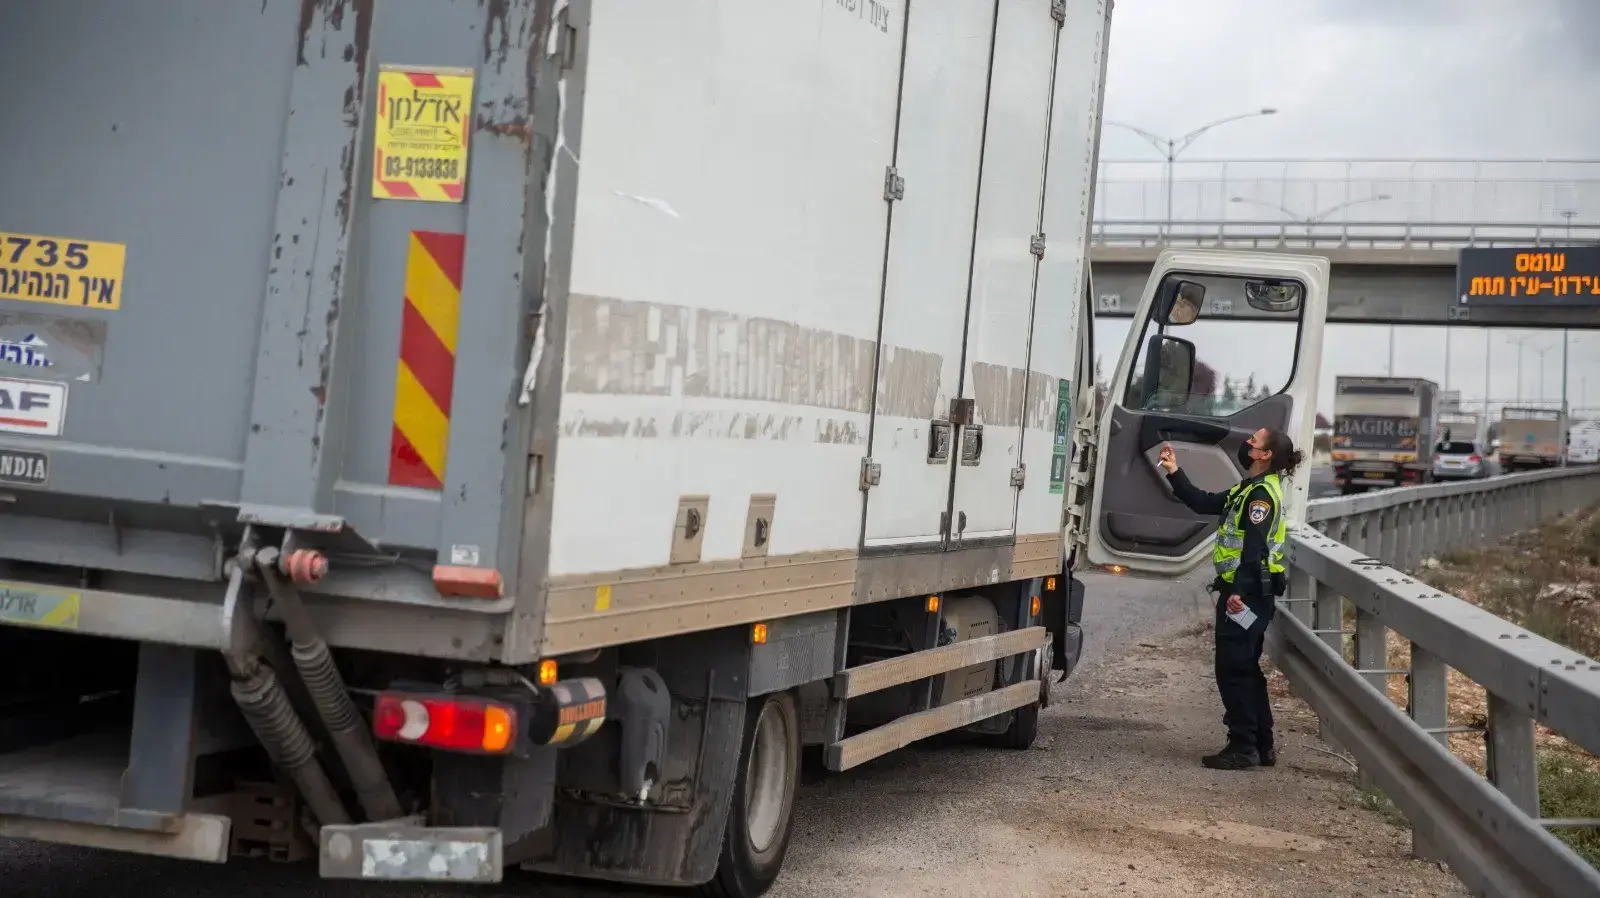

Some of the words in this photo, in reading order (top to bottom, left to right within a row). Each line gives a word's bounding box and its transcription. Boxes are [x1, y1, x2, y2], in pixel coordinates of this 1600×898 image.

[388, 89, 461, 129] אדלמן
[386, 156, 459, 180] 03-9133838
[0, 236, 89, 270] 735
[1515, 252, 1566, 272] עומס
[78, 275, 116, 306] איך
[1469, 276, 1506, 296] תות
